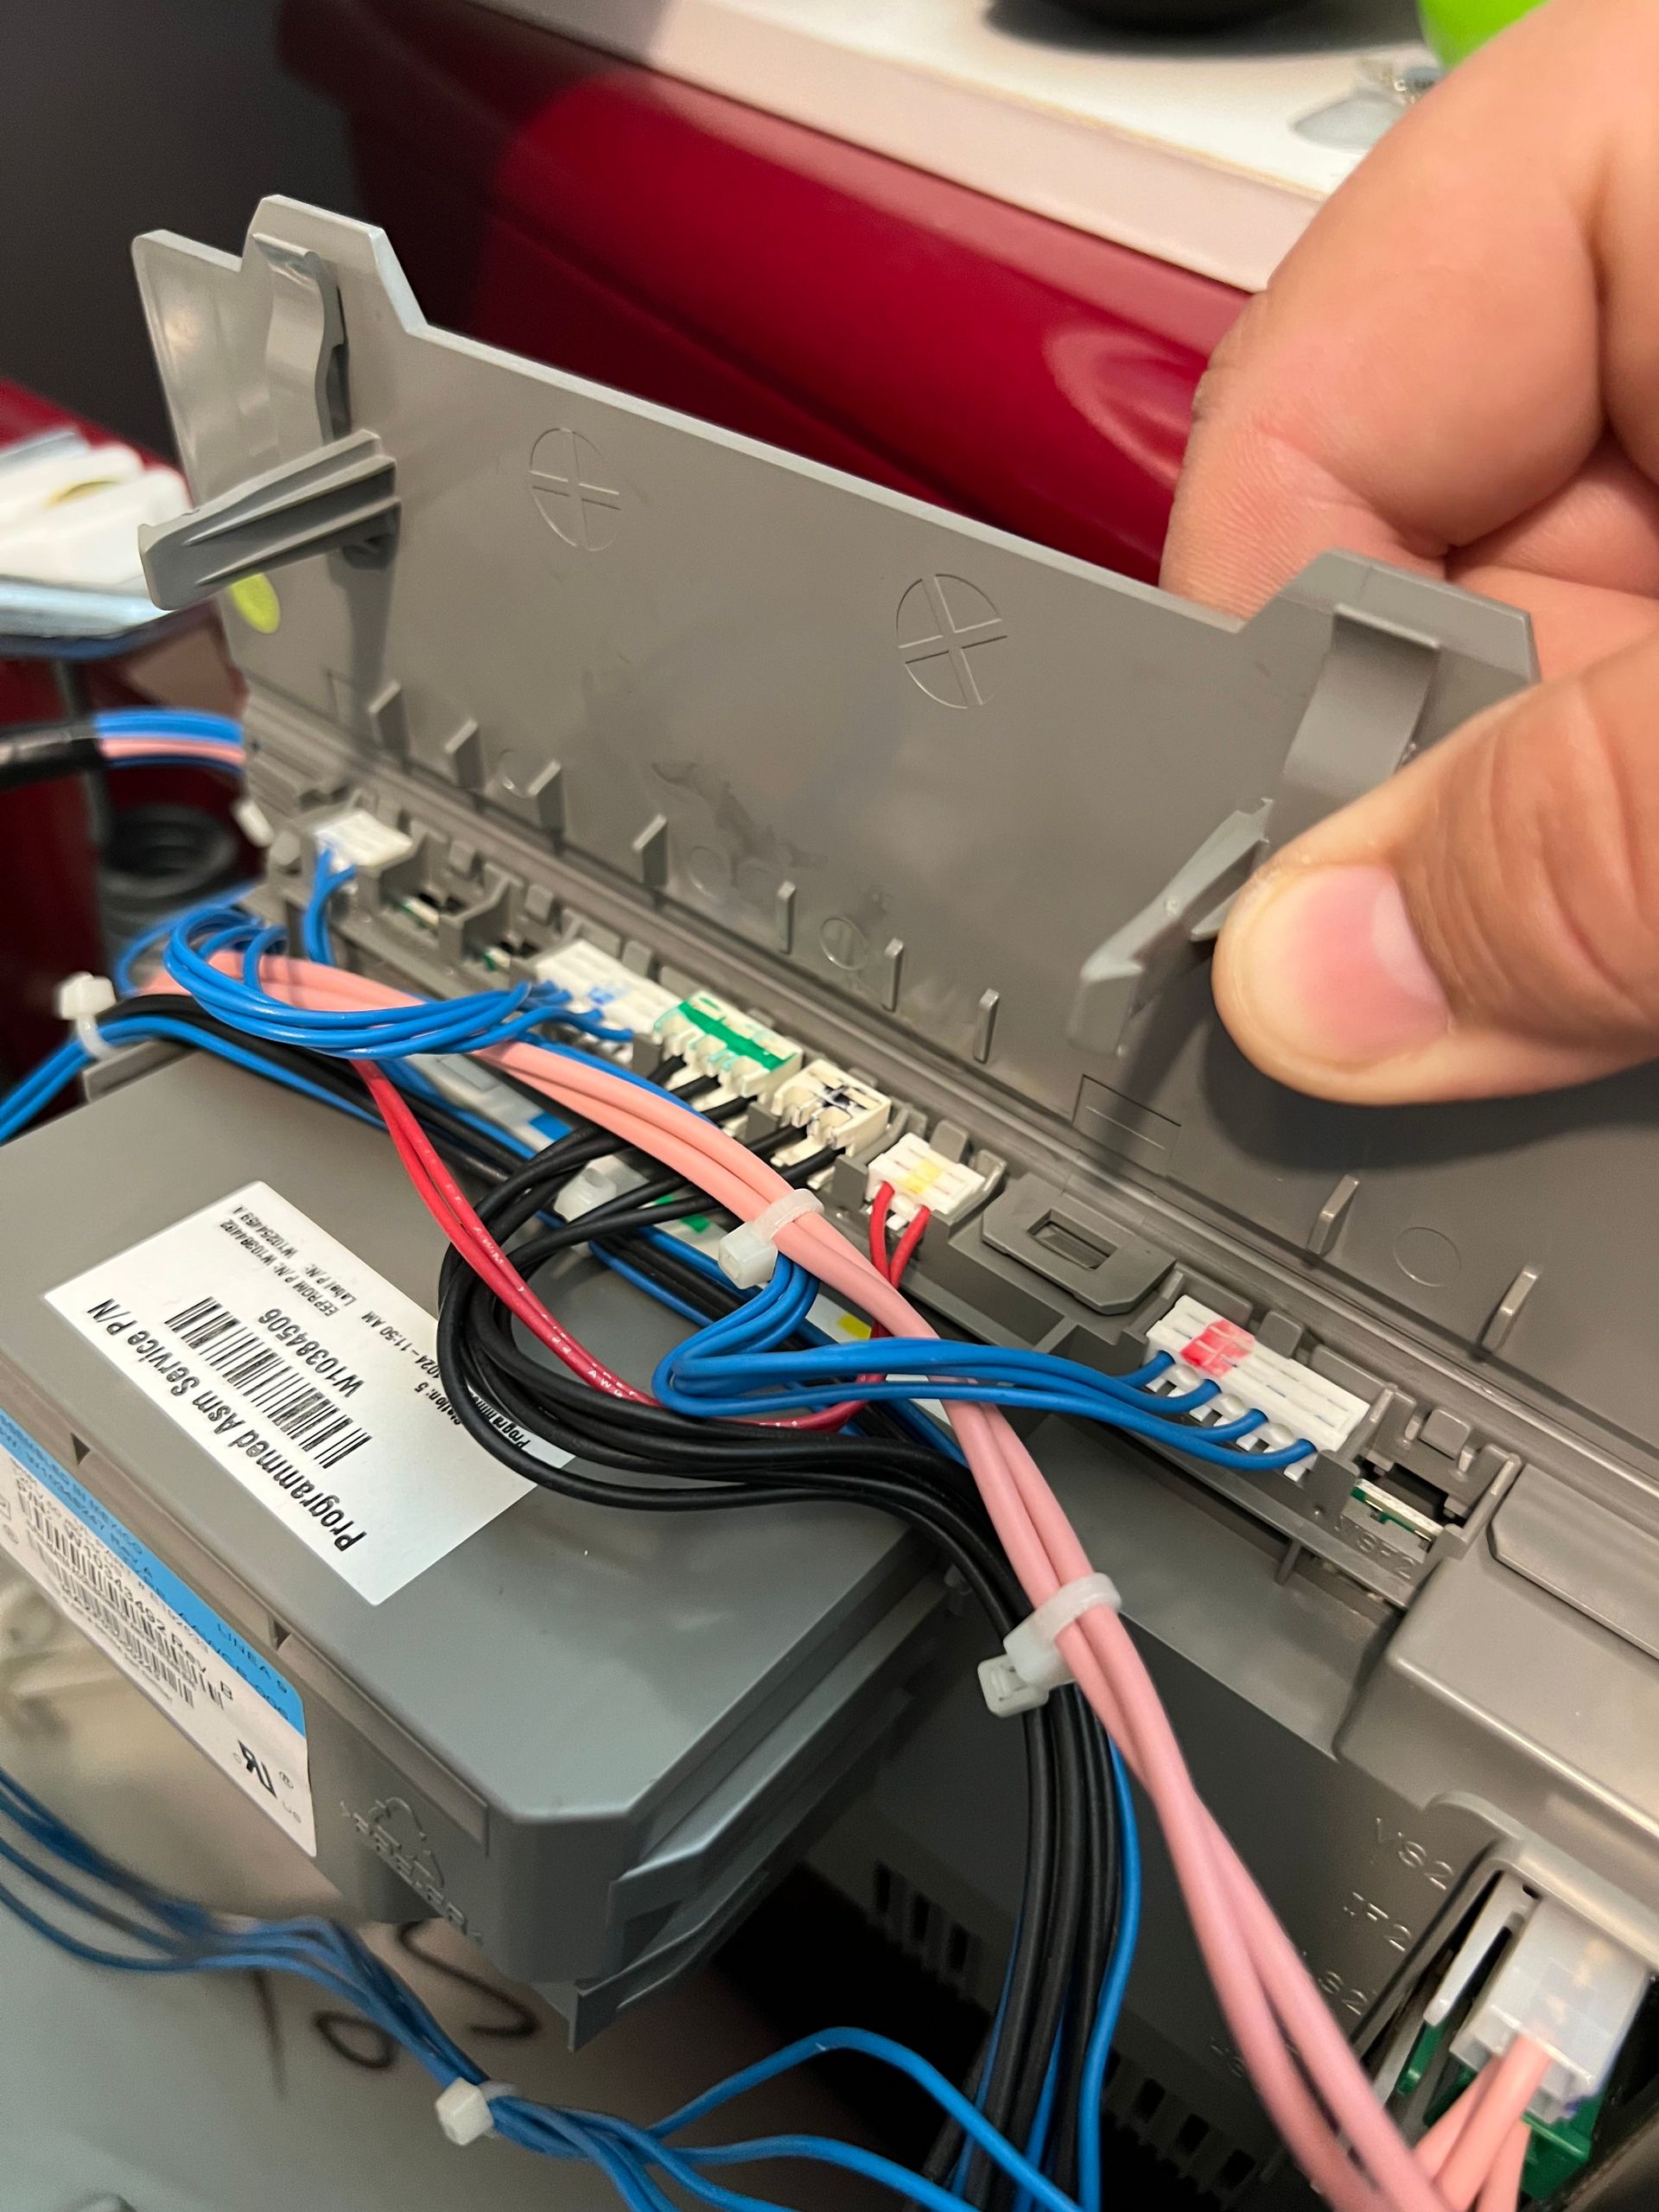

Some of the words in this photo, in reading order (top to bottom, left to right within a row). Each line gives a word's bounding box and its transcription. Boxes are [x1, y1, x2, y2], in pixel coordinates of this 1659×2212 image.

[292, 1281, 339, 1317] EEPROM
[324, 1282, 357, 1306] Label
[86, 1299, 137, 1336] P/N
[361, 1312, 385, 1327] AM
[127, 1331, 200, 1396] Service
[258, 1309, 365, 1398] W10384506
[415, 1382, 429, 1393] 5
[588, 1370, 623, 1397] AWG
[192, 1390, 245, 1434] Asm
[228, 1429, 367, 1552] Programmed
[171, 1631, 207, 1676] Rev
[219, 1679, 232, 1702] B
[217, 1621, 270, 1681] LINEA
[1376, 1817, 1453, 1891] VS2
